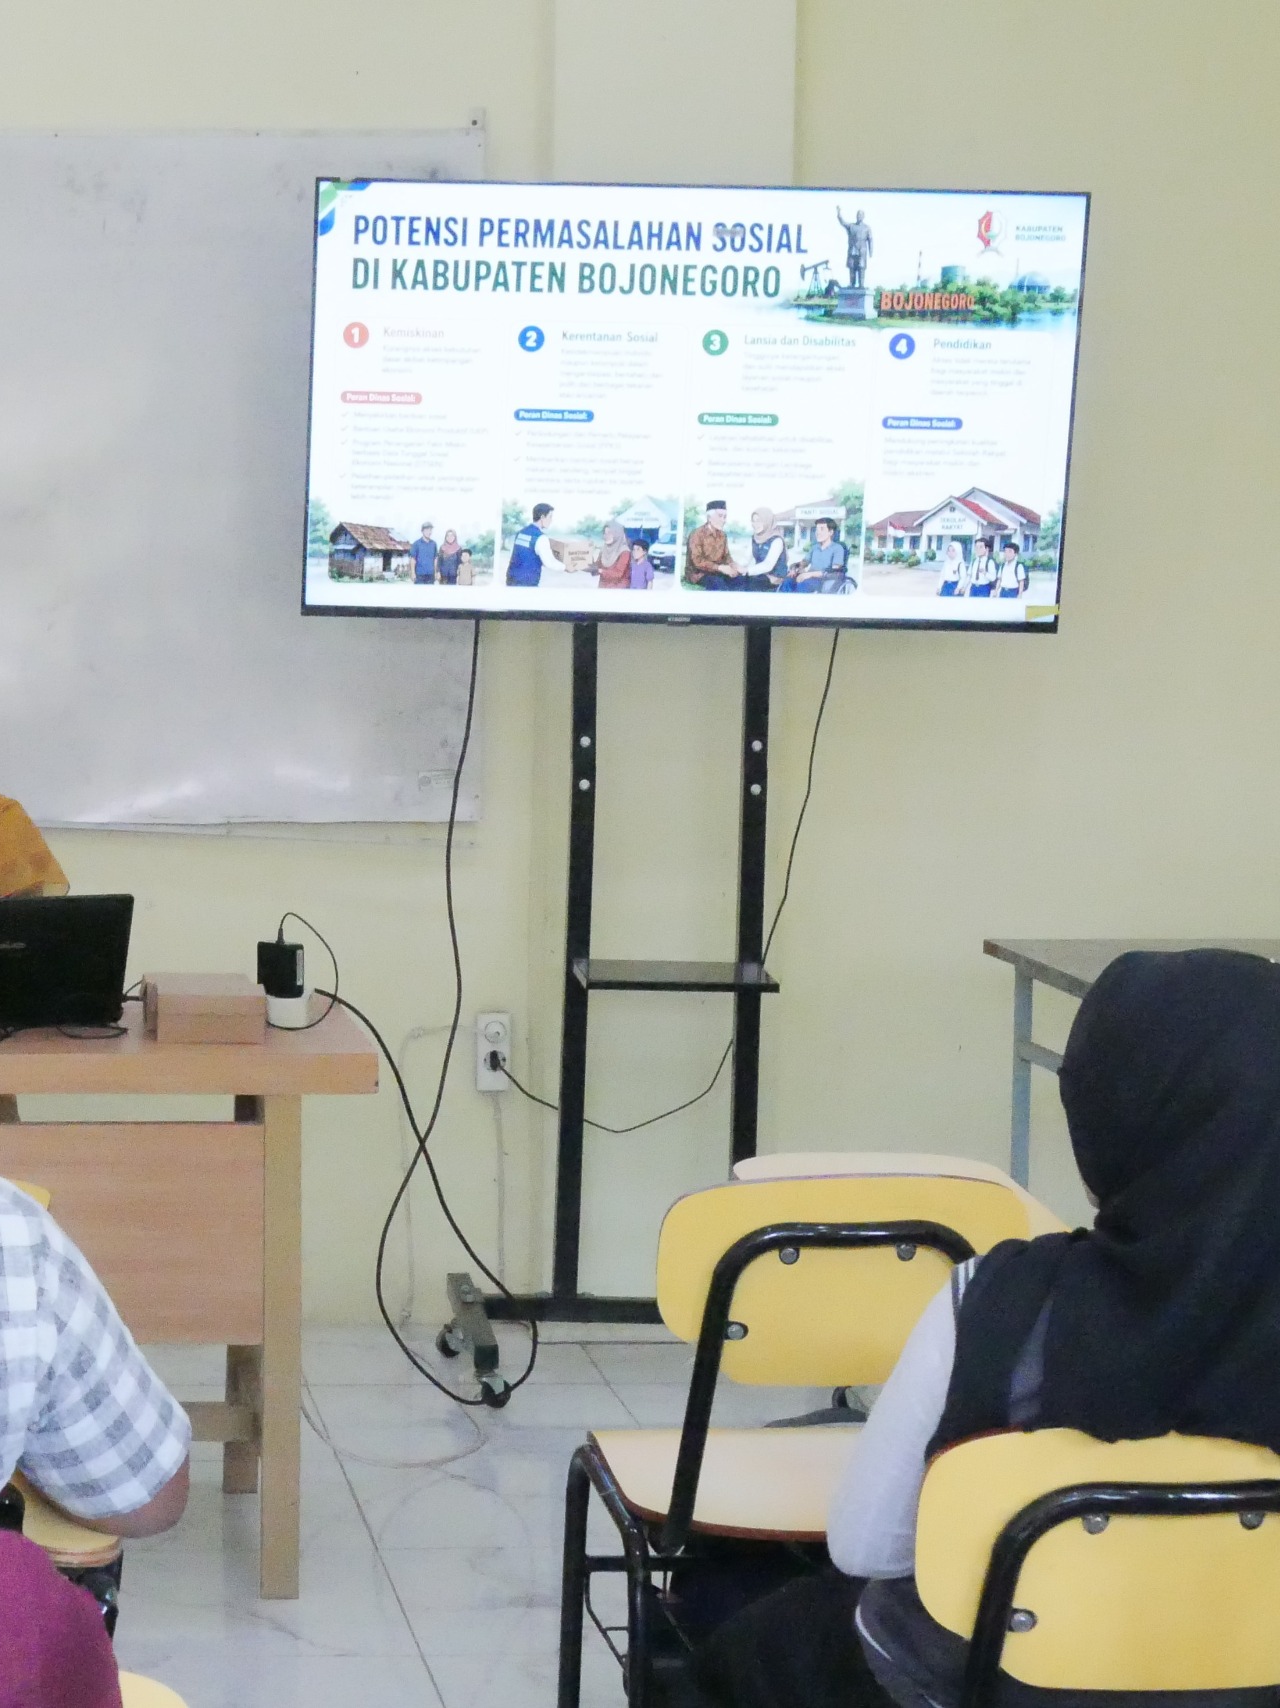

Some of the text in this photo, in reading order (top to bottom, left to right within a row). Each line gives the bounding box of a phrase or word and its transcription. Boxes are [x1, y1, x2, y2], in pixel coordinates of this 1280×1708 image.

[353, 215, 808, 253] POTENSI PERMASALAHAN SOSIAL
[352, 257, 781, 298] DI KABUPATEN BOJONEGORO
[881, 291, 974, 310] BOJONEGORO
[350, 327, 361, 344] 1
[383, 326, 445, 339] Kemiskinan
[526, 332, 537, 347] 2
[562, 330, 659, 343] Kerentanan Sosial
[710, 335, 721, 350] 3
[744, 335, 857, 348] Lansia dan Disabilitas
[896, 339, 908, 354] 4
[933, 338, 992, 351] Pendidikan
[346, 392, 369, 403] Peran
[369, 393, 391, 403] Dinas
[703, 414, 724, 424] Peran
[725, 414, 746, 425] Dinas
[887, 418, 908, 428] Peran
